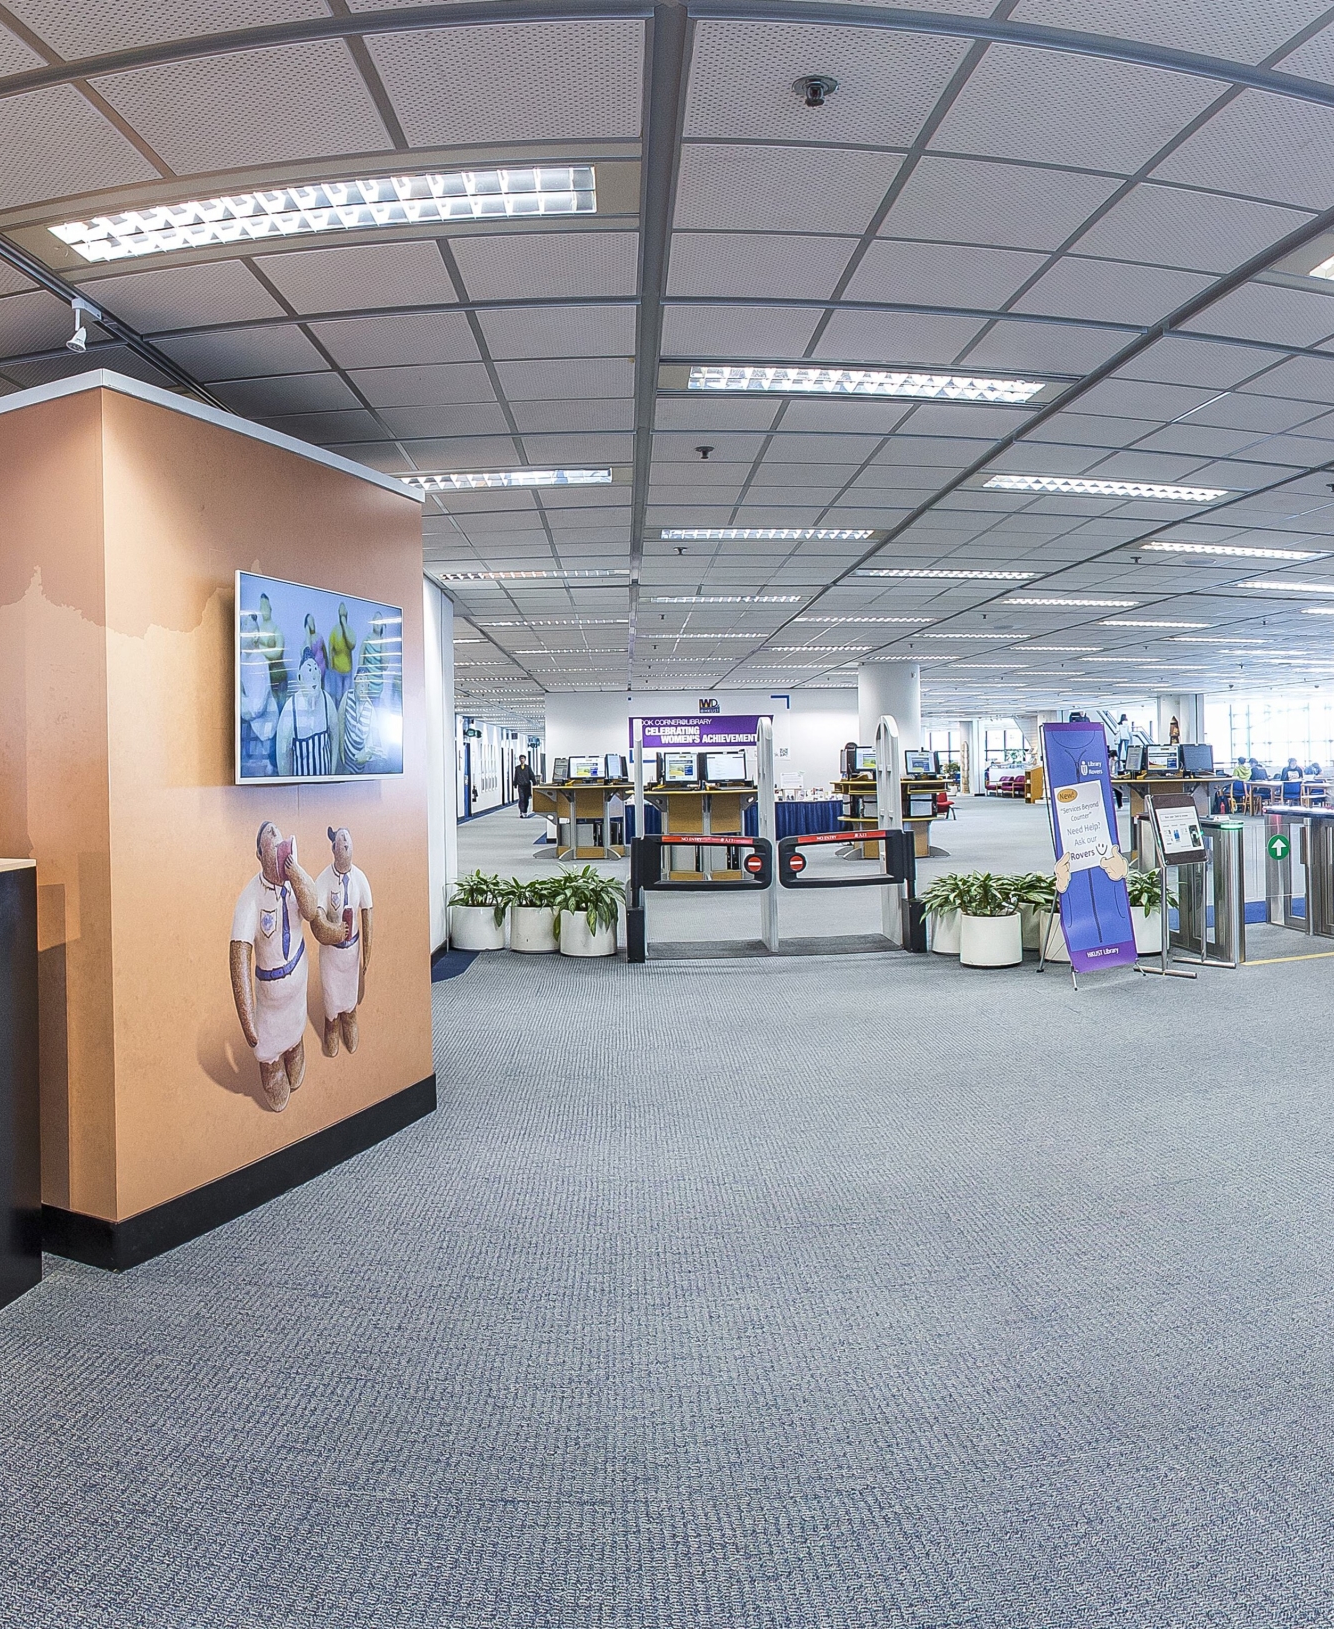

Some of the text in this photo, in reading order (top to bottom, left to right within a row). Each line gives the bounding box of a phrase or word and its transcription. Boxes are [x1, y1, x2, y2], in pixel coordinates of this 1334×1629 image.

[645, 726, 700, 735] CELEBRATING
[661, 734, 700, 744] WOMEN'S
[1059, 791, 1075, 800] New!
[1082, 801, 1099, 810] Beyond
[1067, 822, 1101, 835] Need Help?
[1074, 836, 1097, 846] Ask our
[1071, 849, 1096, 860] Rovers
[1103, 947, 1119, 955] Library
